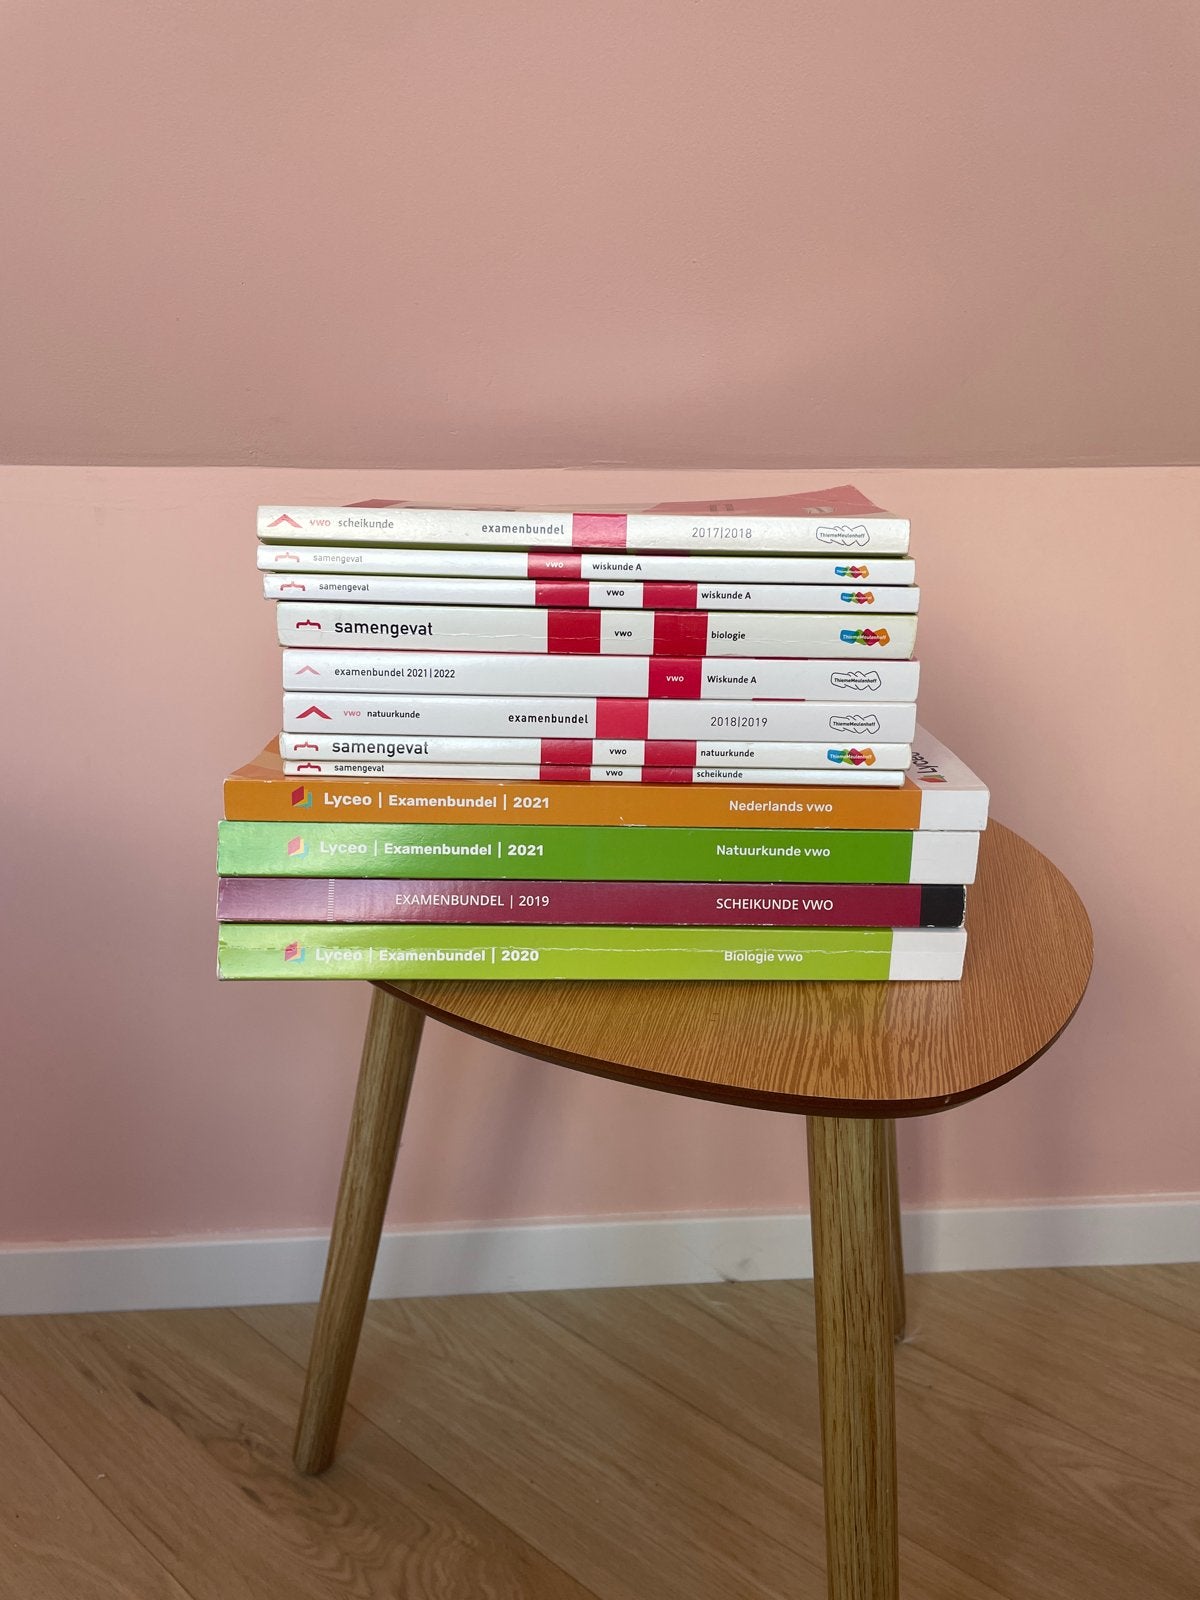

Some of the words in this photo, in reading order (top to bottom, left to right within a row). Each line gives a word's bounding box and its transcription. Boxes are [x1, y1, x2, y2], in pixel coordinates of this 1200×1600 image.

[338, 518, 394, 529] scheikunde
[482, 523, 564, 535] examenbundel
[313, 554, 363, 564] samengevat
[593, 562, 633, 571] wiskunde
[319, 582, 369, 592] samengevat
[702, 591, 742, 600] wiskunde
[335, 620, 433, 638] samengevat
[711, 631, 745, 642] biologie
[334, 667, 404, 678] examenbundel
[707, 675, 748, 684] Wiskunde
[367, 710, 420, 719] natuurkunde
[508, 714, 588, 724] examenbundel
[332, 740, 428, 757] samengevat
[701, 749, 754, 757] natuurkunde
[334, 764, 384, 773] samengevat
[697, 770, 743, 779] scheikunde
[324, 792, 372, 808] Lyceo
[389, 795, 497, 808] Examenbundel
[513, 797, 549, 809] 2021
[729, 801, 802, 812] Nederlands
[806, 803, 832, 812] vwo
[320, 841, 367, 854] Lyceo
[385, 843, 491, 855] Examenbundel
[508, 844, 544, 856] 2021
[716, 845, 802, 857] Natuurkunde
[804, 848, 830, 857] vwo
[396, 895, 504, 906] EXAMENBUNDEL
[519, 896, 549, 907] 2019
[716, 898, 798, 910] SCHEIKUNDE
[802, 899, 833, 910] VWO
[316, 949, 362, 963] Lyceo
[379, 950, 485, 962] Examenbundel
[502, 950, 539, 962] 2020
[724, 951, 774, 964] Biologie
[778, 953, 802, 962] vwo
